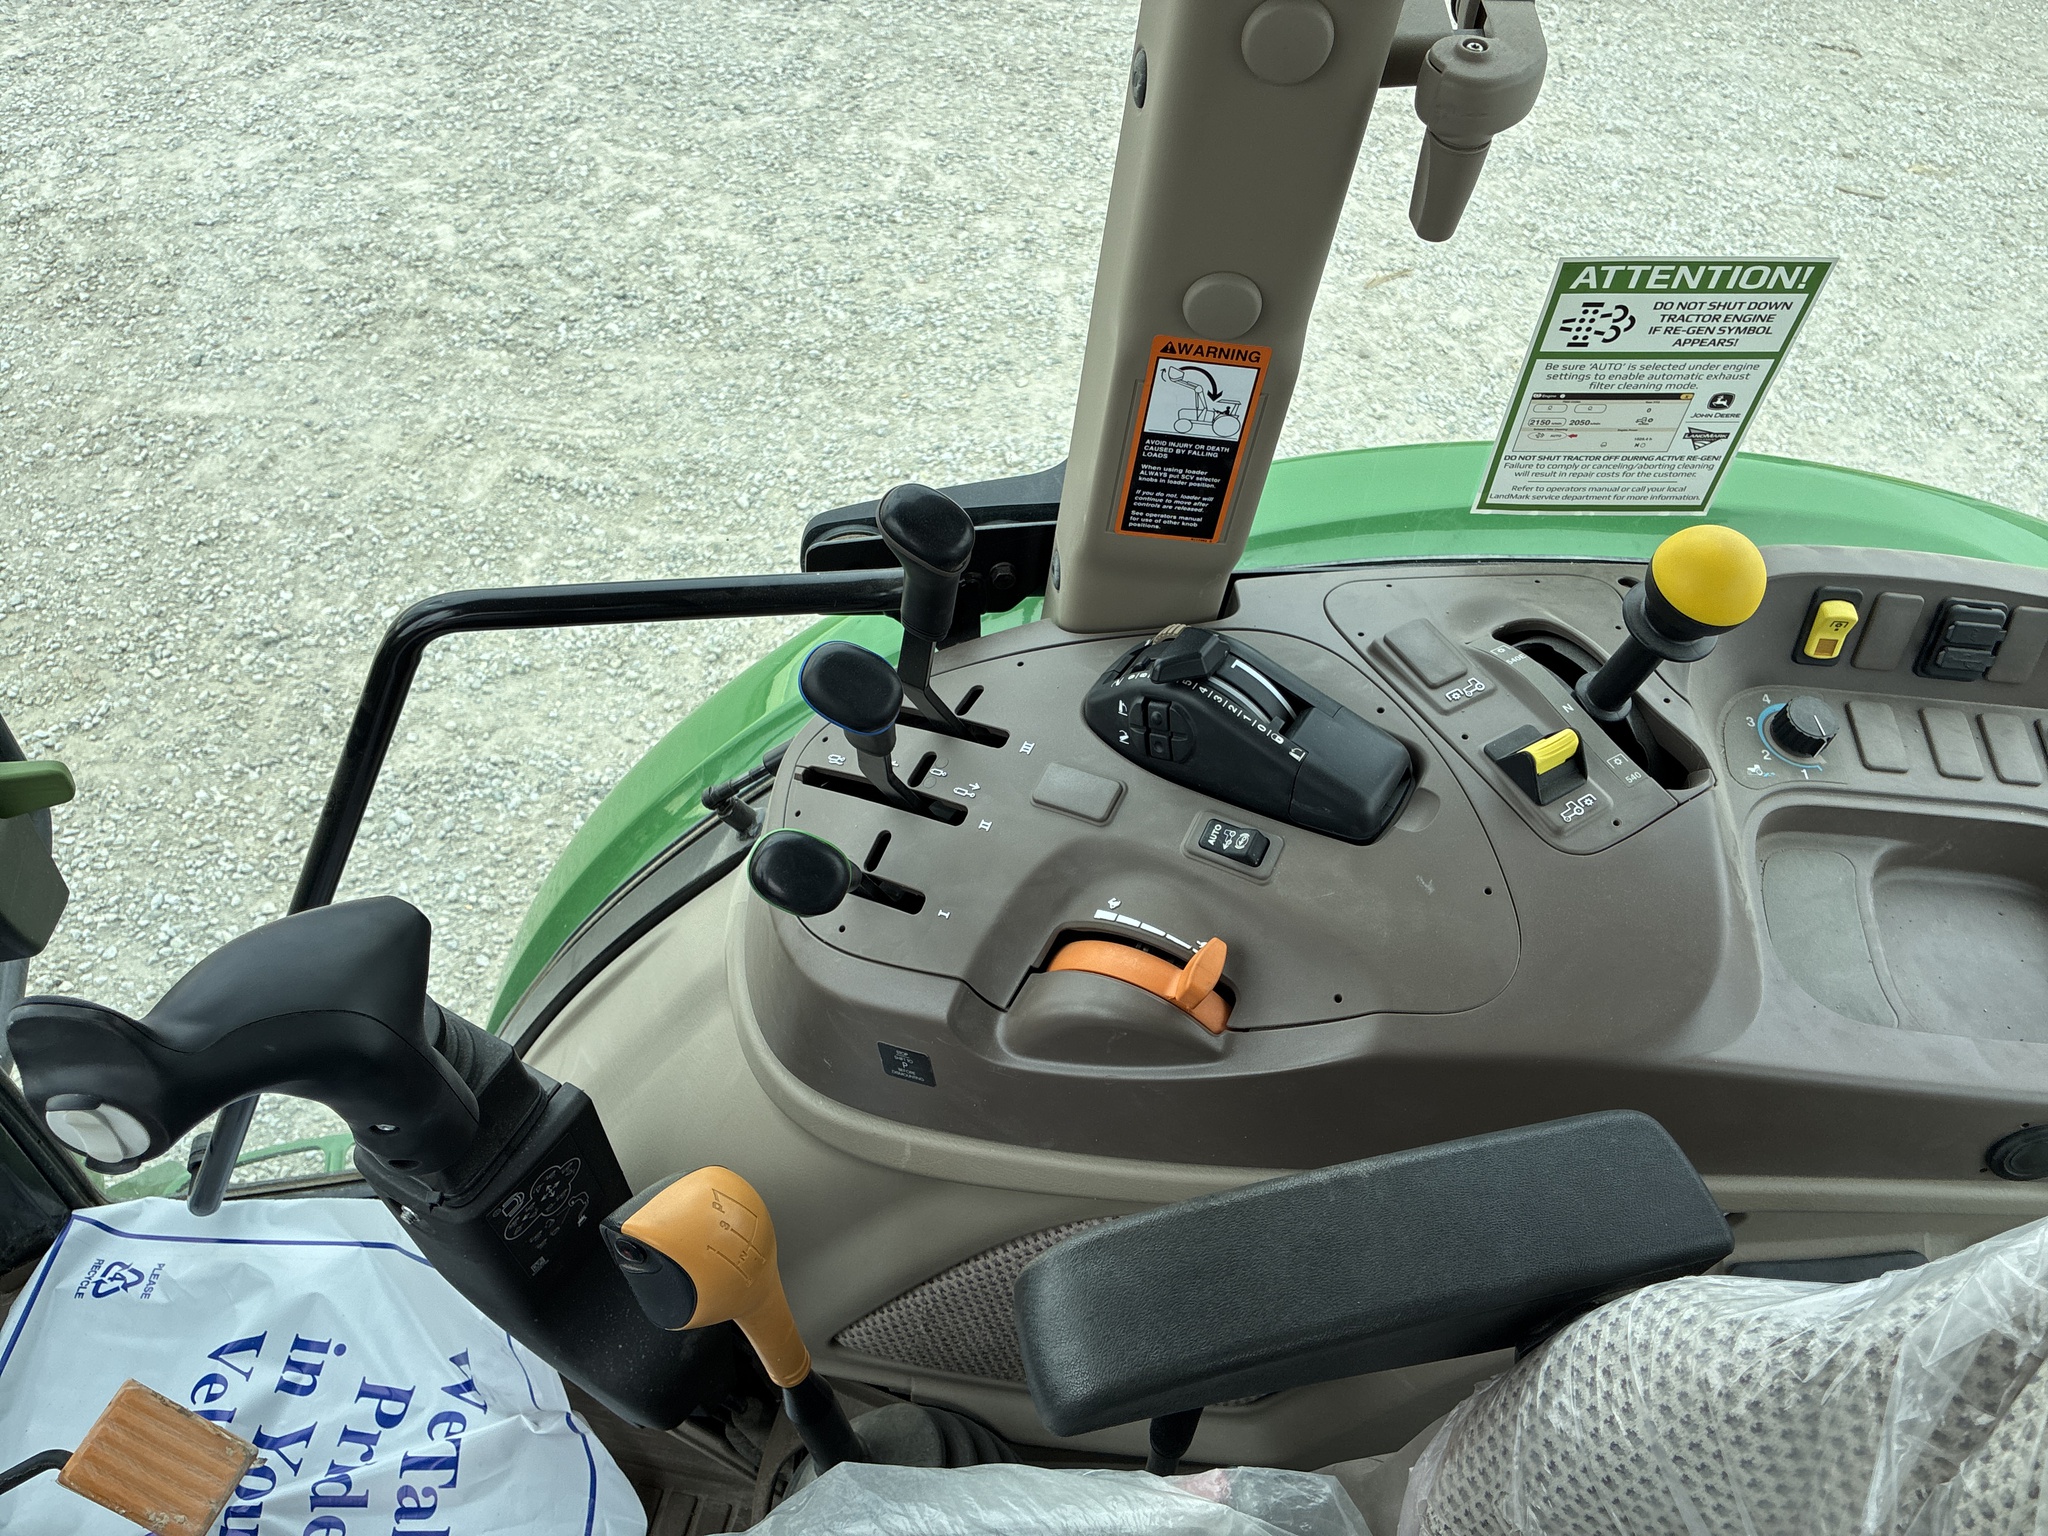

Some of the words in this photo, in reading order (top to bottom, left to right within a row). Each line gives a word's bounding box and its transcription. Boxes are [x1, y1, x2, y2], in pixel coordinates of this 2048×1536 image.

[1568, 265, 1815, 290] ATTENTION!
[1653, 301, 1674, 310] DO
[1676, 301, 1707, 310] NOT
[1707, 301, 1746, 310] SHUT
[1747, 301, 1793, 310] DOWN
[1660, 314, 1721, 323] TRACTOR
[1723, 314, 1777, 323] ENGINE
[1648, 326, 1662, 335] IF
[1663, 326, 1717, 335] RE-GEN
[1717, 326, 1773, 335] SYMBOL
[1672, 338, 1739, 347] APPEARS!
[1178, 342, 1261, 363] WARNING
[1545, 363, 1559, 371] Be
[1627, 363, 1637, 371] is
[1638, 363, 1687, 371] selected
[1688, 363, 1721, 371] under
[1722, 363, 1760, 372] engine
[1546, 372, 1591, 382] settings
[1608, 372, 1645, 380] enable
[1647, 372, 1704, 380] automatic
[1706, 372, 1750, 380] exhaust
[1589, 381, 1615, 390] filter
[1617, 382, 1663, 391] cleaning
[1665, 382, 1699, 390] mode.
[1144, 445, 1174, 453] CAUSED
[1187, 450, 1219, 458] FALLING
[1168, 441, 1193, 449] INJURY
[1206, 445, 1230, 453] DEATH
[1142, 451, 1168, 459] LOADS
[1163, 466, 1183, 474] using
[1185, 468, 1208, 476] loader
[1549, 462, 1580, 470] comply
[1592, 463, 1675, 471] canceling/aborting
[1677, 463, 1715, 471] cleaning
[1139, 470, 1168, 478] ALWAYS
[1188, 481, 1216, 489] position.
[1134, 495, 1164, 503] continue
[1133, 501, 1161, 509] controls
[1174, 505, 1204, 513] released.
[1145, 512, 1177, 520] operators
[1505, 652, 1528, 665] 540E
[1182, 679, 1192, 687] 5
[1213, 695, 1223, 703] 3
[1762, 693, 1771, 704] 4
[1228, 705, 1238, 713] 2
[1562, 703, 1574, 713] N
[1243, 714, 1252, 722] 1
[1746, 716, 1755, 727] 3
[1257, 724, 1267, 732] 0
[1761, 749, 1772, 760] 2
[1625, 771, 1642, 784] 540
[1801, 768, 1809, 780] 1
[1208, 824, 1222, 846] AUTO
[711, 1201, 725, 1214] P
[706, 1244, 716, 1253] 1
[738, 1250, 748, 1262] N
[74, 1258, 105, 1299] RECYCLE
[108, 1272, 127, 1282] 4
[140, 1263, 166, 1299] PLEASE
[274, 1333, 348, 1398] in
